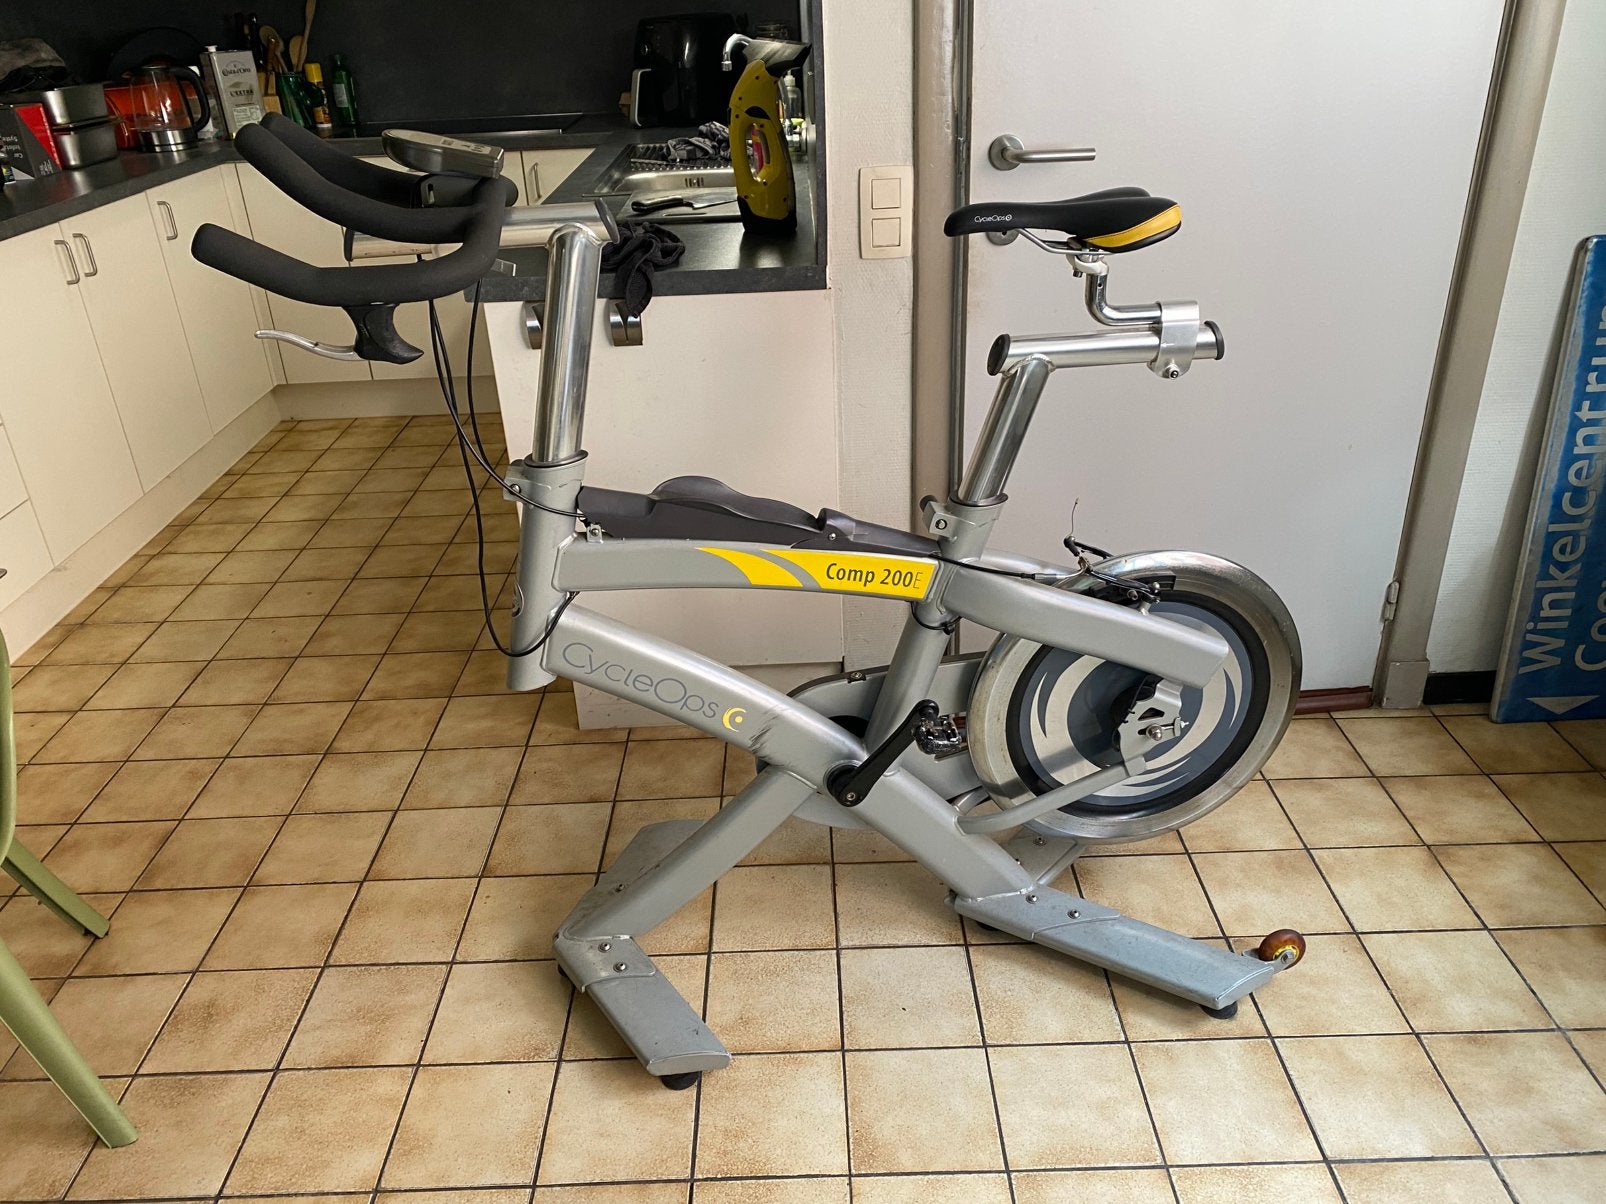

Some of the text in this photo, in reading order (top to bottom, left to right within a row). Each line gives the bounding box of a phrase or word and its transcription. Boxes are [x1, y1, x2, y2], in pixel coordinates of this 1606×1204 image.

[974, 214, 1006, 223] CycleOps
[826, 562, 923, 589] Comp 200E
[562, 642, 719, 718] CycleOps
